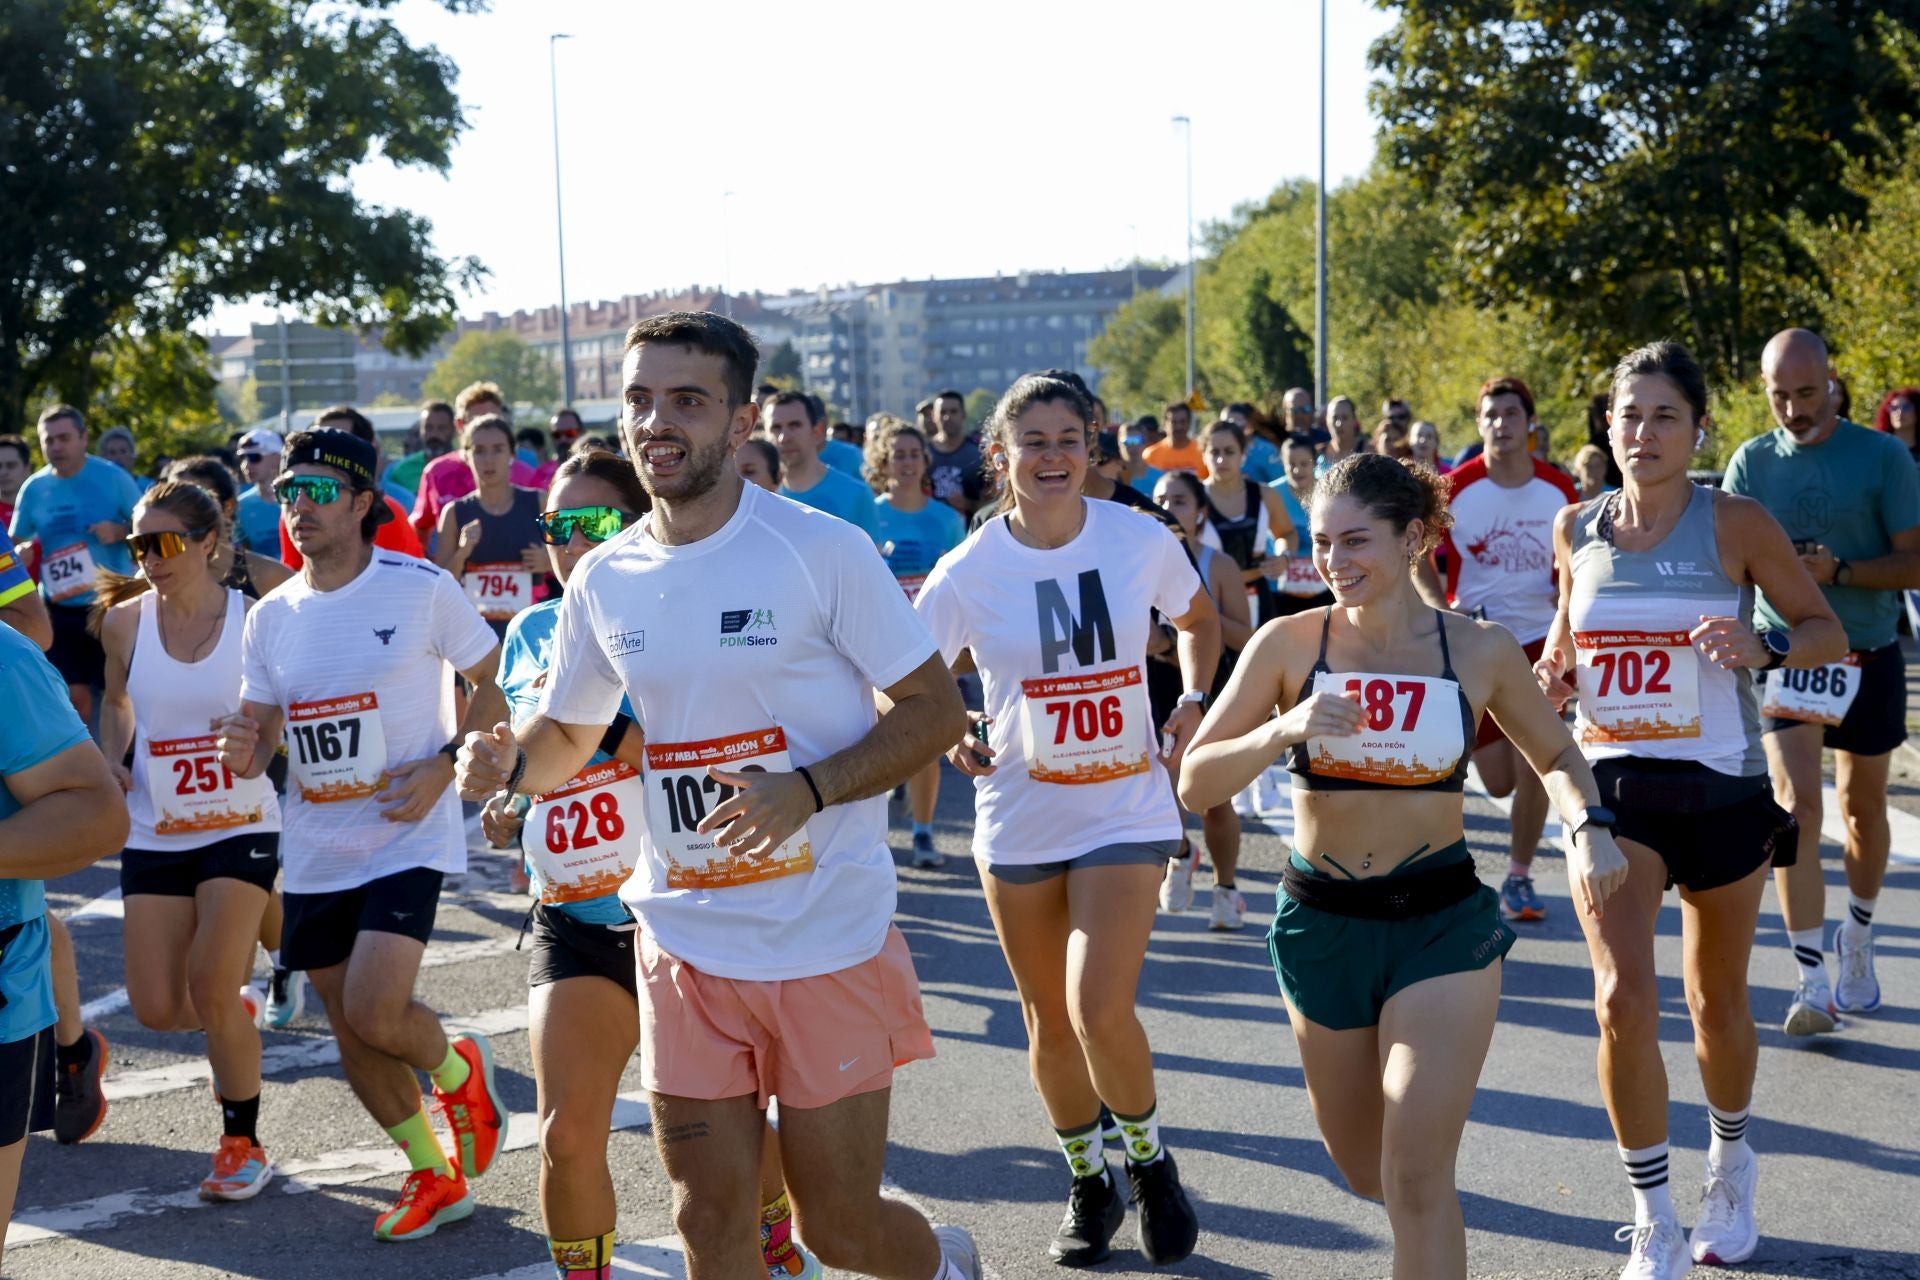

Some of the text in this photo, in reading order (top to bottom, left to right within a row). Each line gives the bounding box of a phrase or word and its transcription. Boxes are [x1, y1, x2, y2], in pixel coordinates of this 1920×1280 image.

[324, 453, 351, 469] NIKE
[49, 556, 82, 582] 524
[478, 575, 519, 597] 794
[720, 636, 777, 647] PDMSiero
[1601, 635, 1626, 644] MBA
[1591, 650, 1671, 697] 702
[1783, 664, 1848, 697] 1086
[1056, 682, 1081, 692] MBA
[297, 707, 318, 717] MBA
[1045, 695, 1123, 745] 706
[176, 742, 198, 751] MBA
[292, 718, 360, 764] 1167
[675, 750, 699, 762] MBA
[724, 739, 759, 755] GIJÓN
[1362, 742, 1383, 750] AROA
[172, 756, 234, 795] 251
[586, 768, 616, 784] GIJÓN
[661, 765, 767, 833] 102
[545, 792, 625, 854] 628
[686, 843, 711, 851] SERGIO
[563, 851, 620, 869] SANDRA SALINAS
